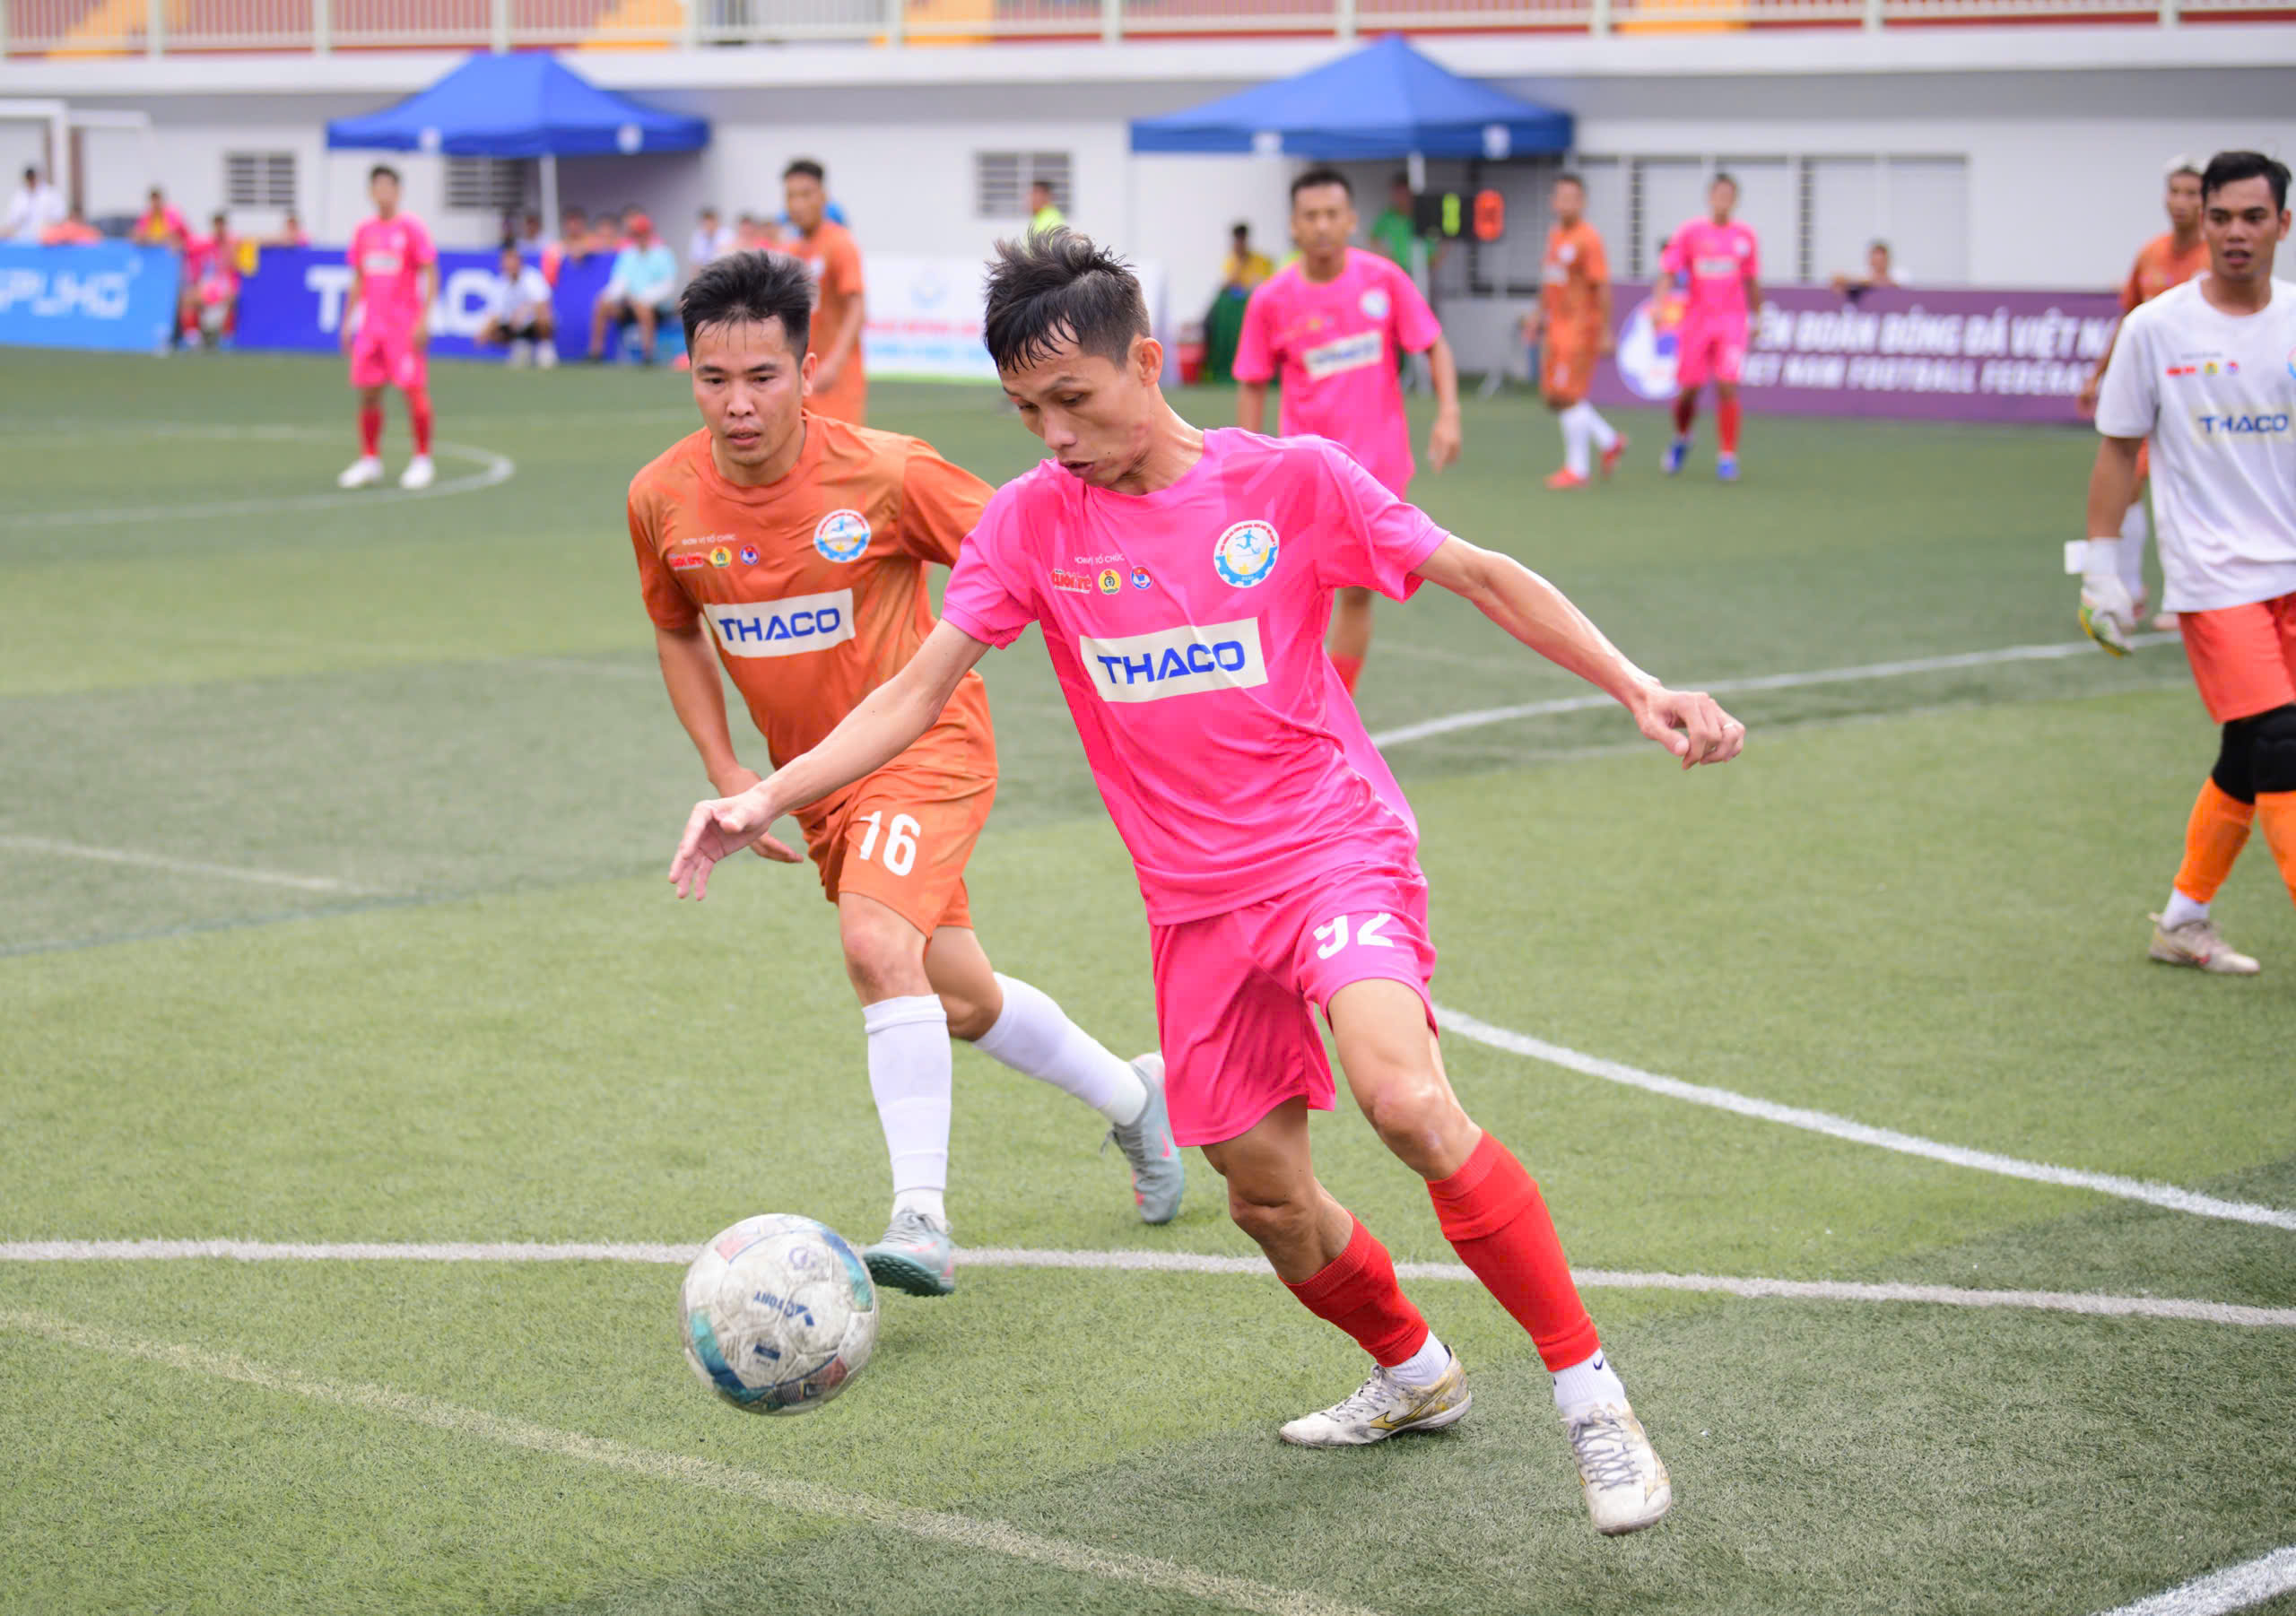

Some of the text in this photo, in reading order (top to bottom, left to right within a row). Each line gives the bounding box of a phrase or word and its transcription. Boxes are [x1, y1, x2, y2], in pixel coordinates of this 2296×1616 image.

[2199, 413, 2290, 433] THACO
[718, 608, 840, 642] THACO
[1097, 640, 1246, 684] THACO
[858, 811, 921, 876] 16
